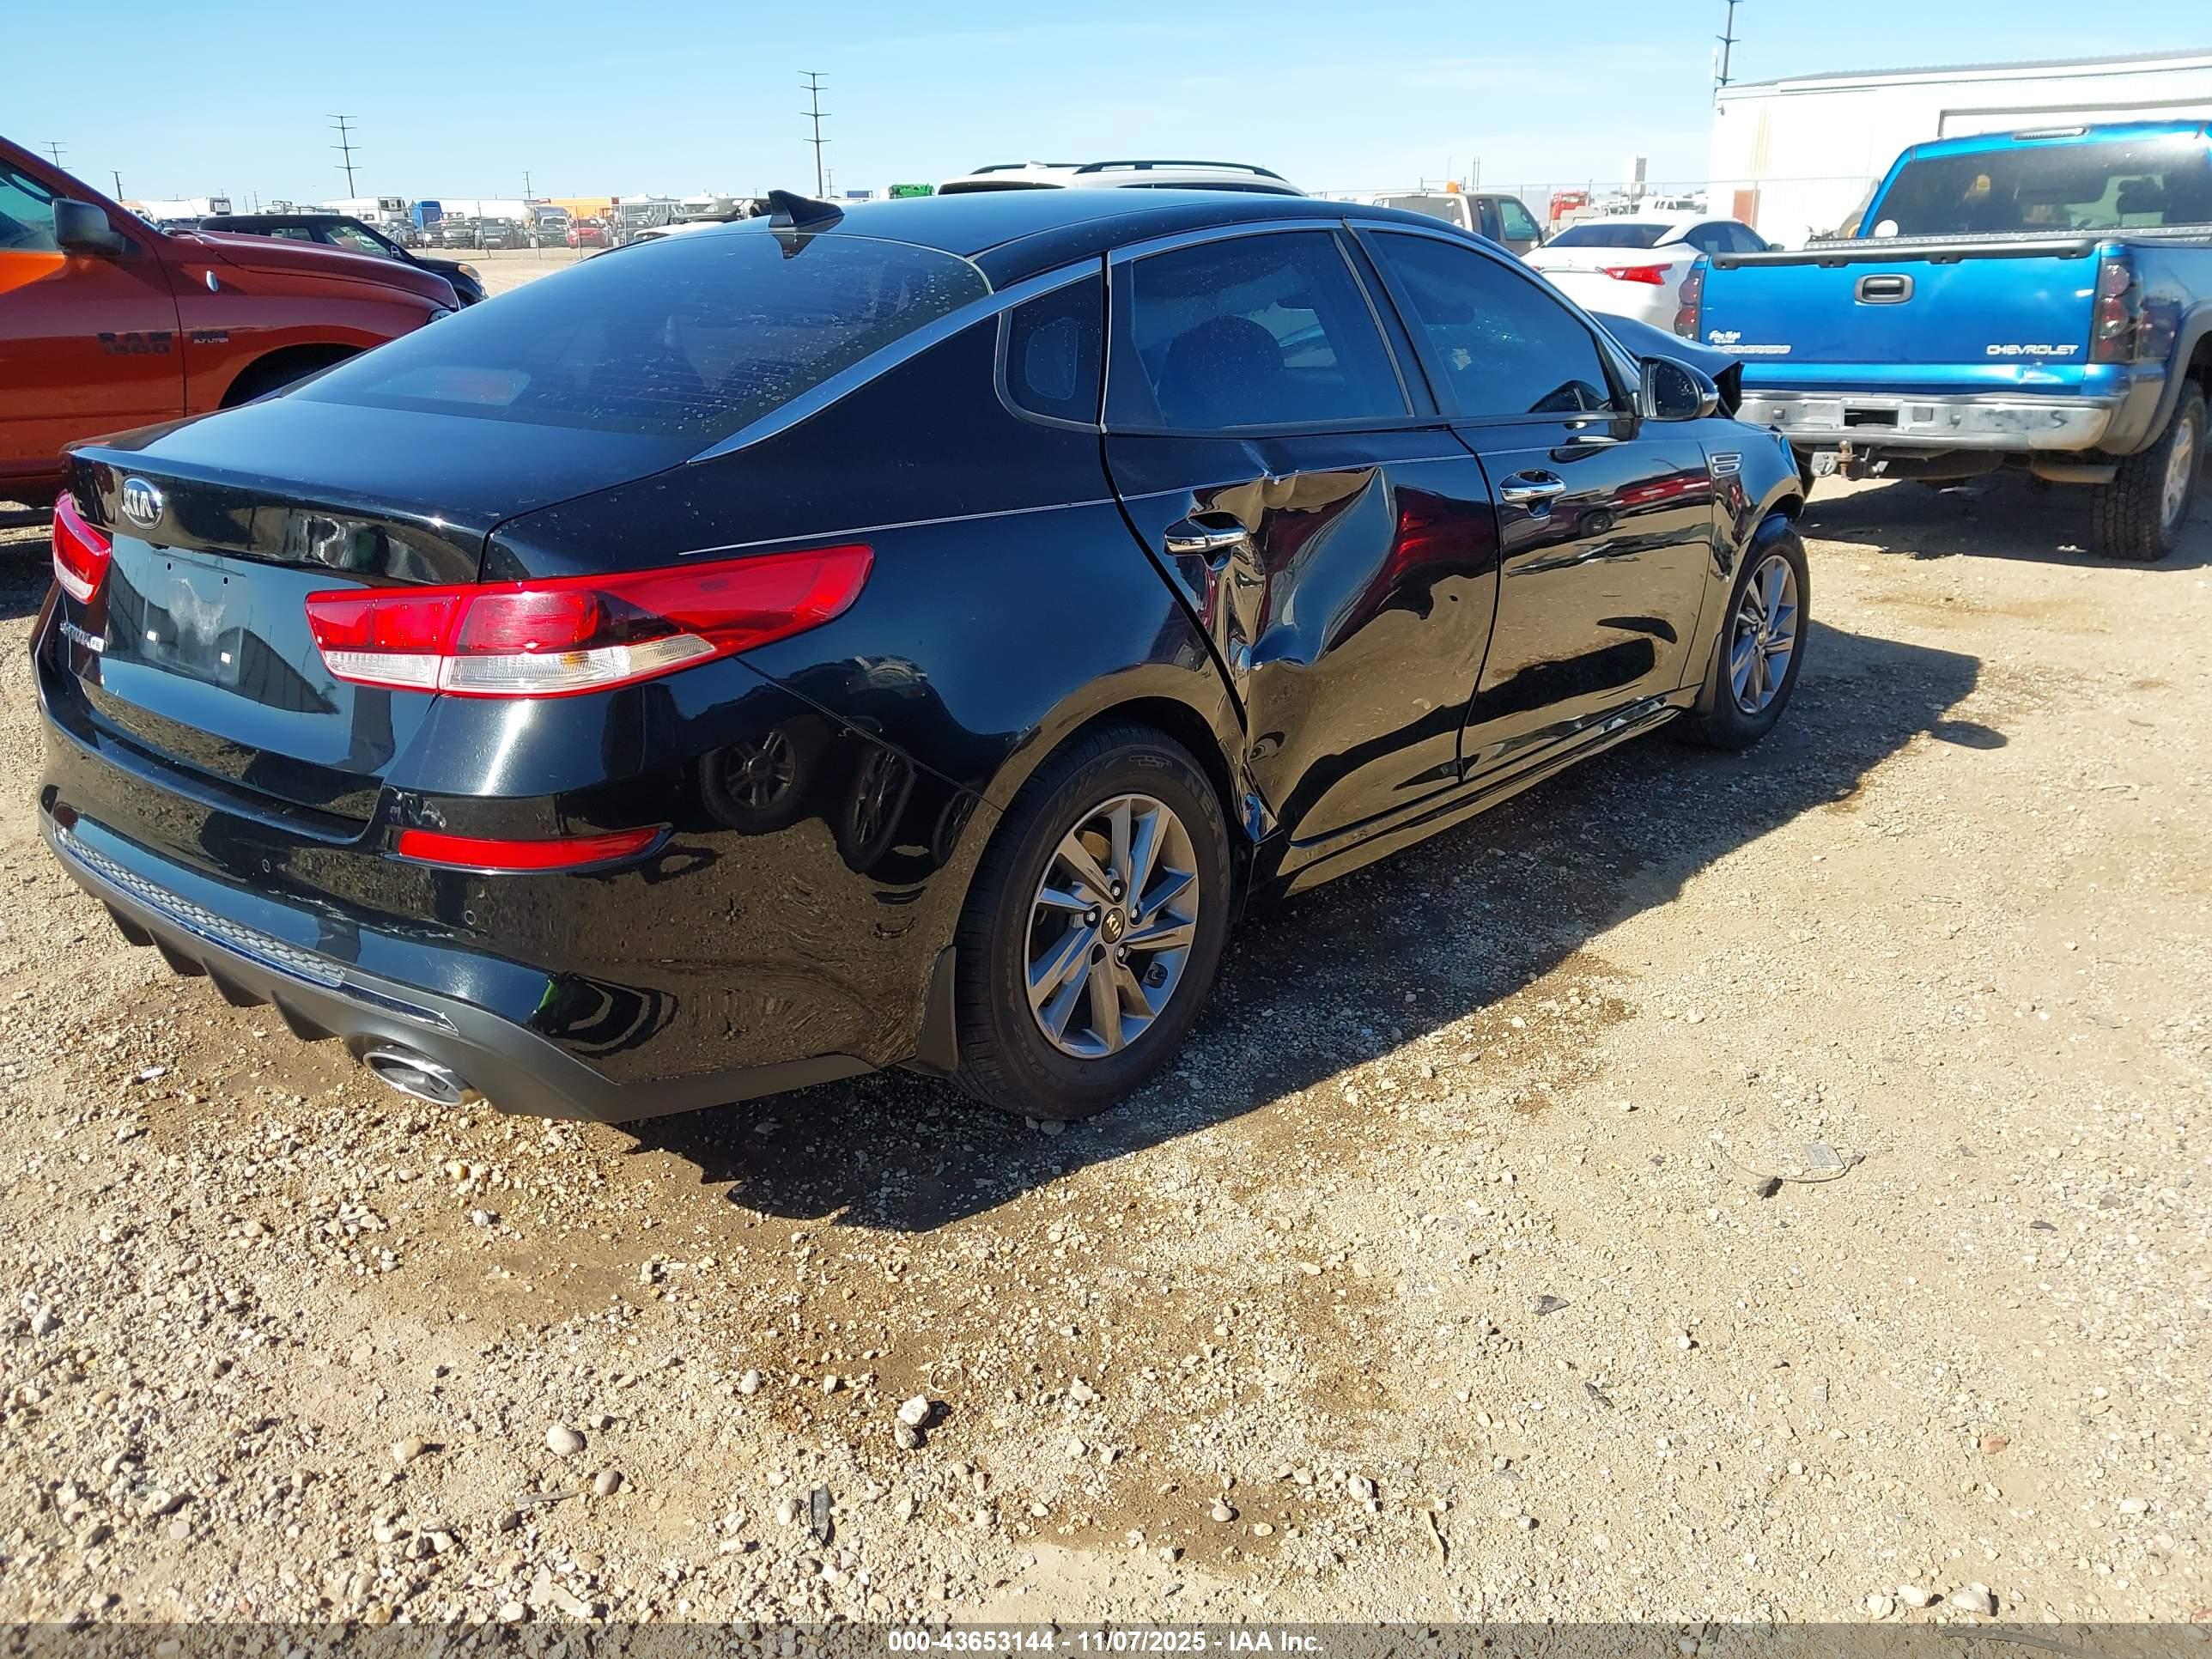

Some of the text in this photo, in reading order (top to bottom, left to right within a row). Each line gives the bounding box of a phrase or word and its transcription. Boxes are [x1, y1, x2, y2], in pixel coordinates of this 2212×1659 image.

[1986, 344, 2080, 355] CHEVROLET
[122, 486, 155, 519] KIA
[1106, 913, 1122, 939] KIA
